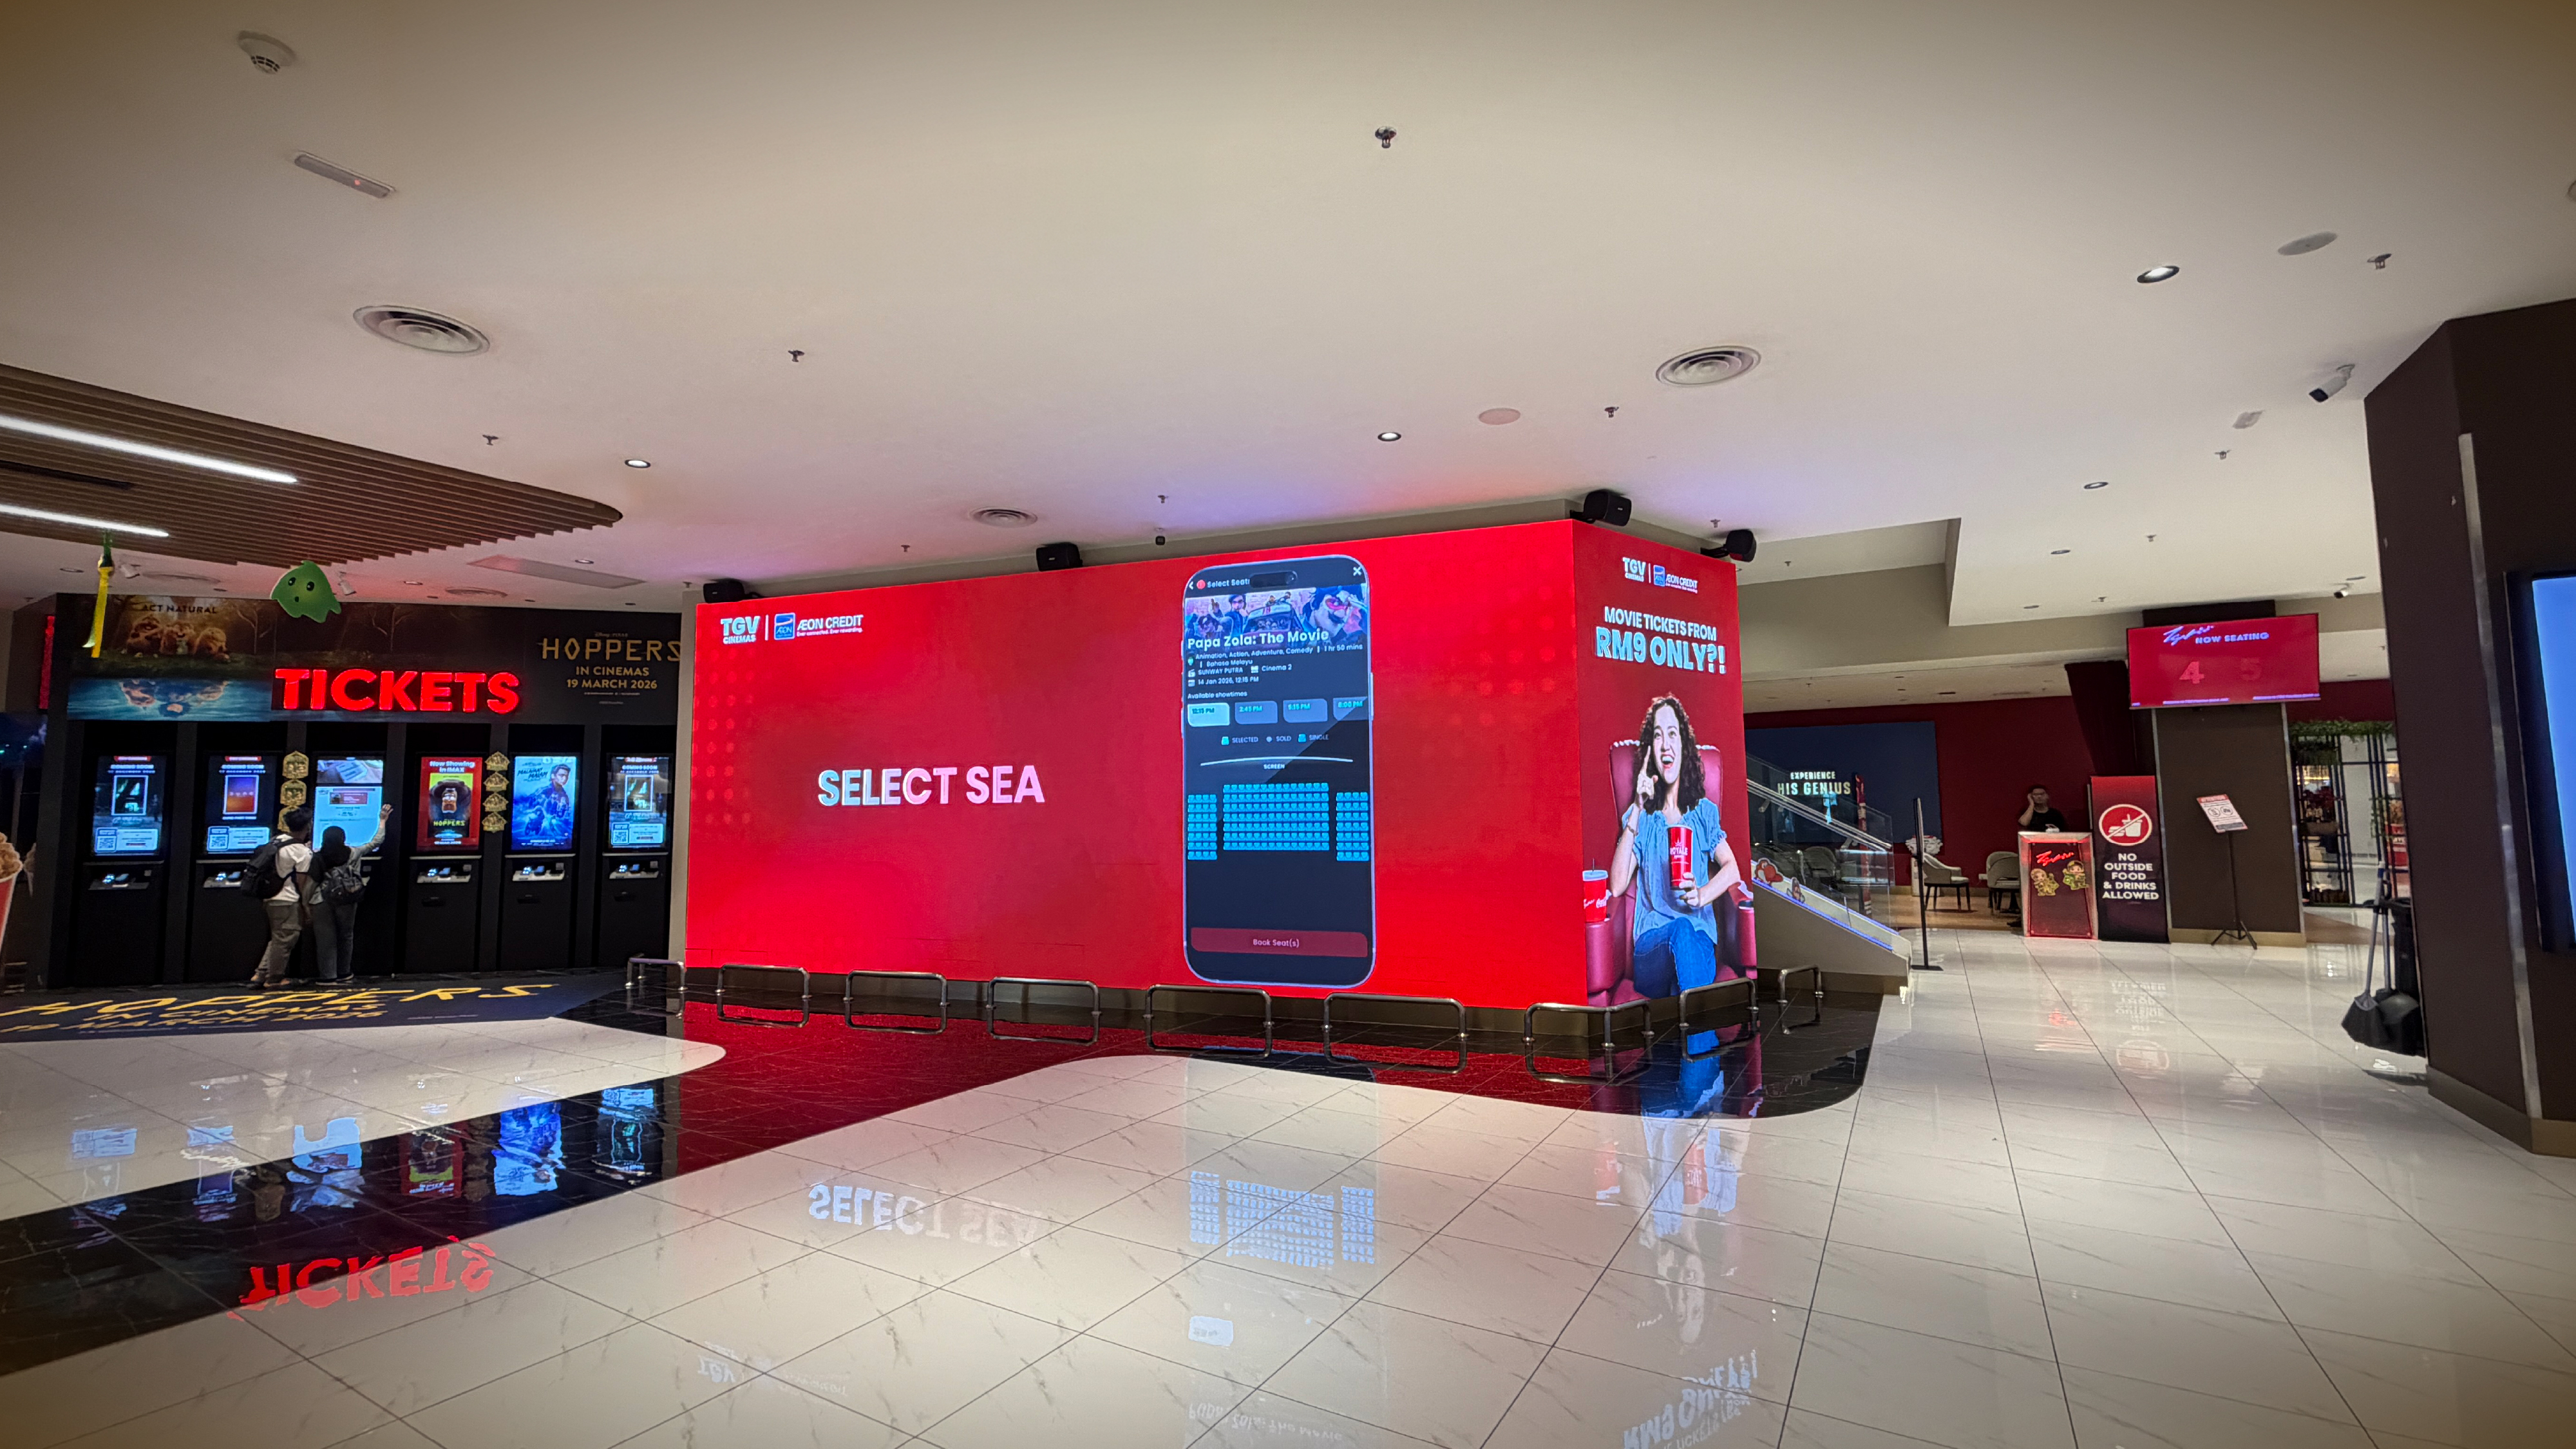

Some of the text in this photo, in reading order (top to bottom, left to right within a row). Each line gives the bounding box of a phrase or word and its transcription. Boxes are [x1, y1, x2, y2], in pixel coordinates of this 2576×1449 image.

[1622, 557, 1646, 575] TGV
[1680, 577, 1698, 589] CREDIT
[167, 605, 217, 614] NATURAL
[721, 616, 761, 636] TGV
[825, 614, 864, 629] CREDIT
[1604, 606, 1717, 641] MOVIE TICKETS FROM
[723, 635, 756, 645] CINEMAS
[1188, 629, 1329, 652] Papa Zola: The Movie
[2195, 636, 2221, 644] NOW
[2224, 632, 2269, 642] SEATING
[542, 638, 681, 662] HOPPERS
[1595, 626, 1727, 674] RM9 ONLY?!
[576, 665, 649, 676] IN CINEMAS
[2179, 661, 2205, 684] 4
[274, 668, 520, 714] TICKETS
[567, 678, 658, 689] 19 MARCH 2026
[1790, 771, 1836, 780] EXPERIENCE
[818, 764, 1045, 807] SELECT SEA
[1777, 781, 1851, 796] HIS GENIUS
[2118, 853, 2137, 862] NO
[2104, 862, 2153, 871] OUTSIDE
[2112, 872, 2146, 880] FOOD
[2115, 882, 2157, 891] DRINKS
[2102, 891, 2159, 900] ALLOWED
[0, 984, 558, 1016] HOPPERS
[159, 1003, 385, 1018] CINEMAS
